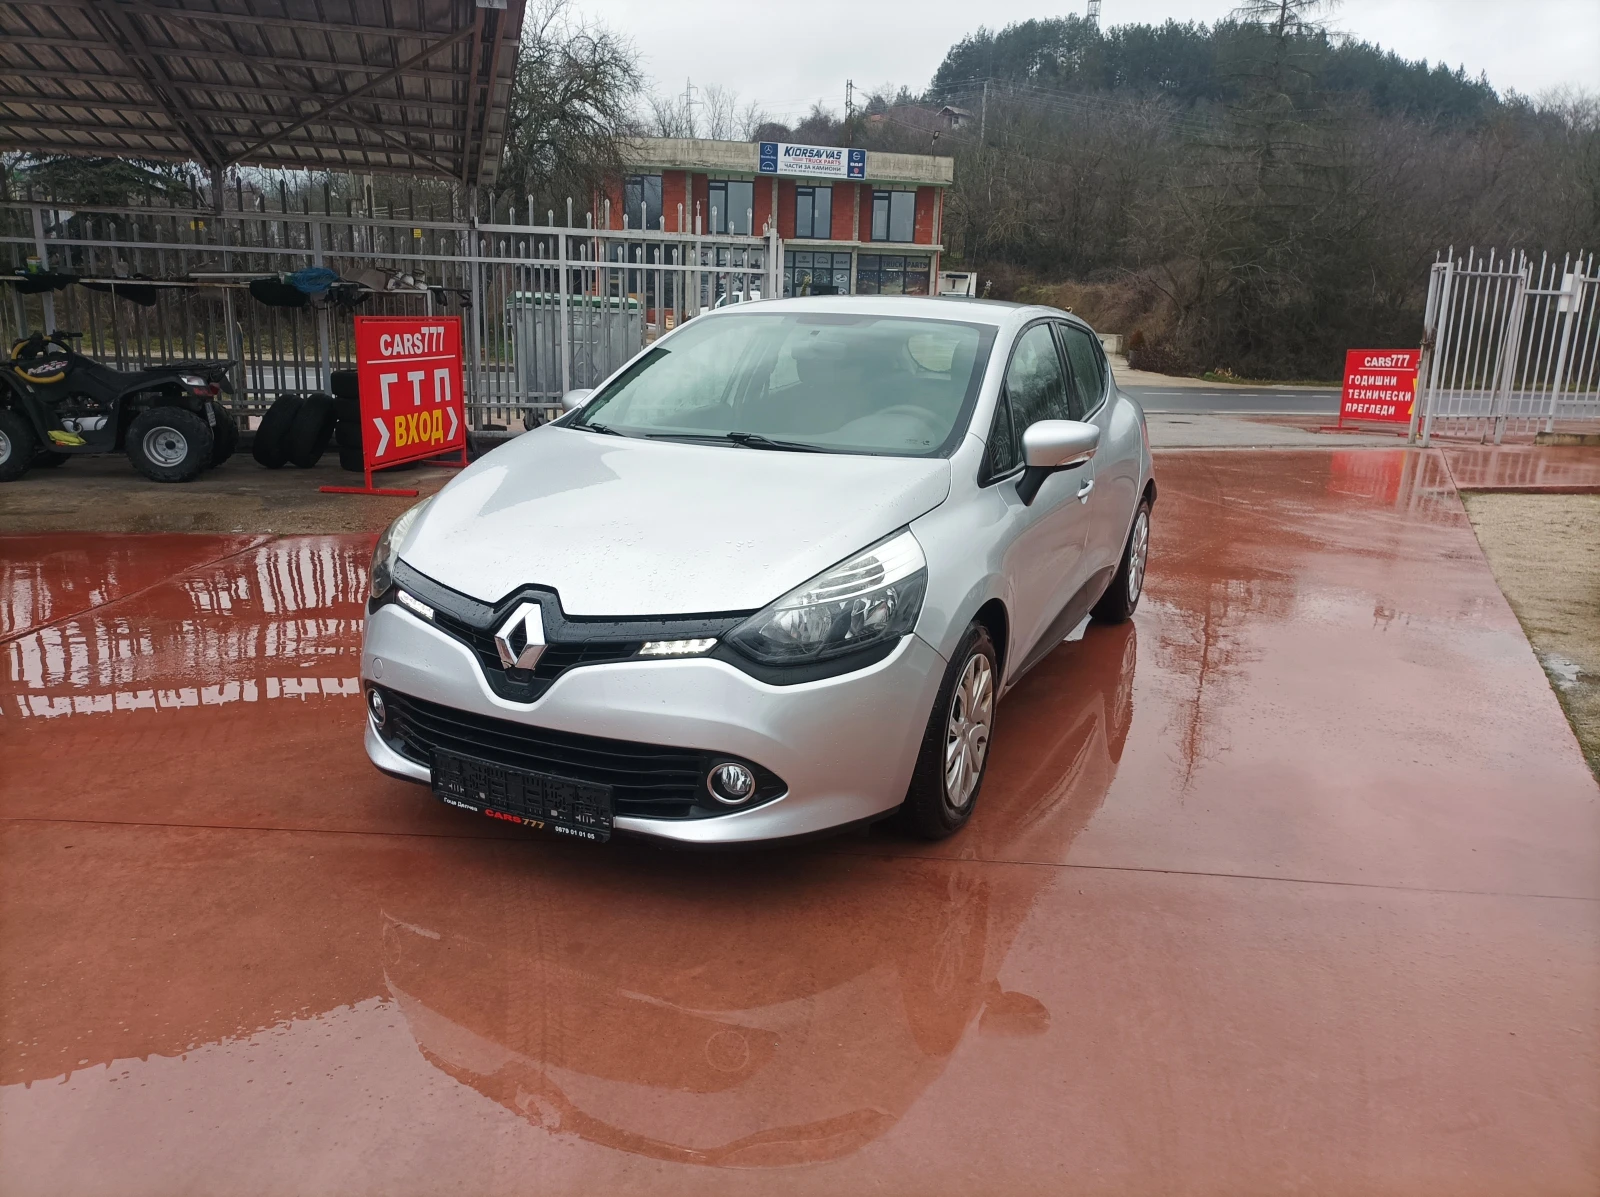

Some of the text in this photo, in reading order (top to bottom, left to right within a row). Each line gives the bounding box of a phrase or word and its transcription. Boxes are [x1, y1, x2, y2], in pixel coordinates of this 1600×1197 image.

[882, 260, 928, 269] TRUCK PARTS
[379, 326, 445, 356] CARS777
[1364, 354, 1410, 367] CARS777
[1348, 375, 1397, 386] ГОДИШНИ
[1348, 389, 1412, 402] ТЕХНИЧЕСКИ
[1345, 403, 1395, 416] ПРЕГЛЕДИ
[394, 409, 444, 447] ВХОД
[578, 830, 586, 838] 01
[587, 832, 595, 840] 05
